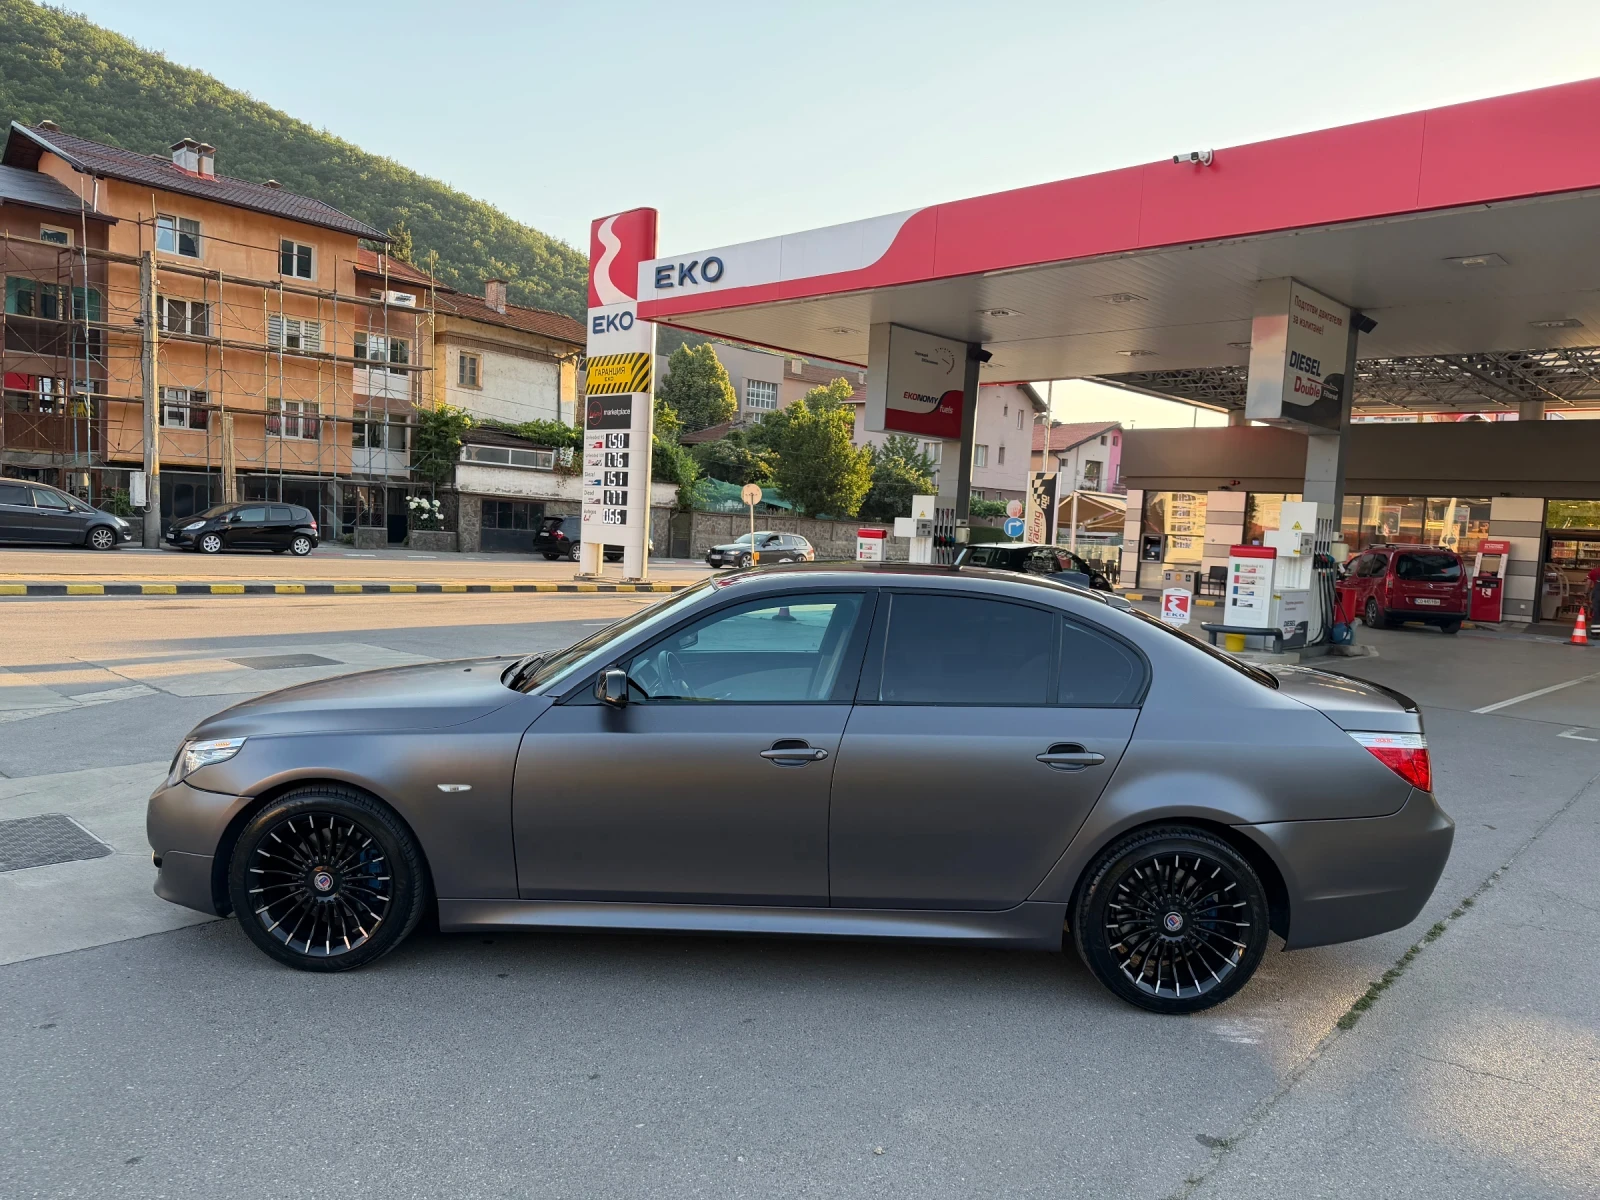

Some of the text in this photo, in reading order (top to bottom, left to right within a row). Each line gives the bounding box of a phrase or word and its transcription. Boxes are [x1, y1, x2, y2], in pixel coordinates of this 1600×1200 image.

[654, 256, 724, 289] EKO
[592, 310, 634, 335] EKO
[594, 366, 626, 377] ГАРАНЦИЯ
[1289, 350, 1321, 377] DIESEL
[903, 391, 939, 404] EKONOMY
[1294, 376, 1321, 398] Double
[603, 408, 631, 416] marketplace
[939, 404, 954, 414] fuels
[1032, 510, 1043, 544] racing
